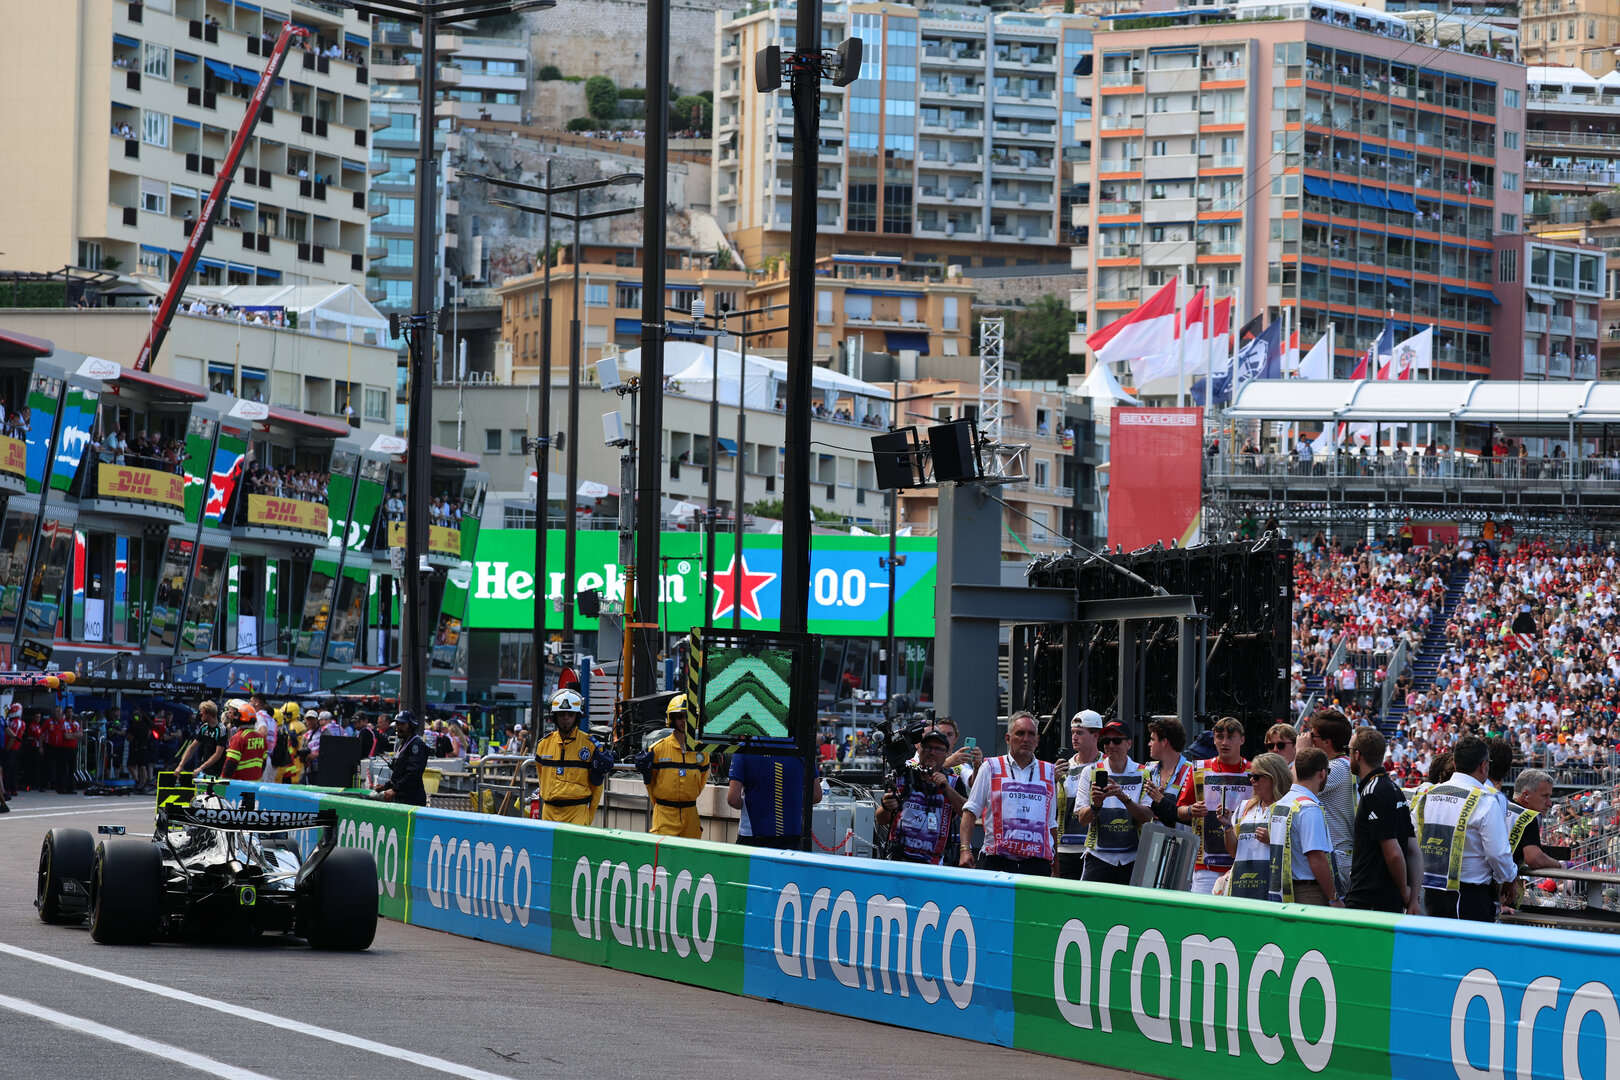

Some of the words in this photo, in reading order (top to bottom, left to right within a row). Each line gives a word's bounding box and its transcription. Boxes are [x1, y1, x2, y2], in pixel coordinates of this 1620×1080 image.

[1121, 414, 1195, 425] BELVEDERE
[115, 470, 154, 496] DHL
[264, 500, 299, 522] DHL
[17, 677, 32, 686] Bull
[195, 809, 318, 826] CROWDSTRIKE
[1021, 805, 1031, 813] TV
[1456, 794, 1478, 832] MONACO
[1004, 829, 1044, 844] MEDIA
[1509, 812, 1532, 846] MONACO
[1002, 840, 1019, 850] PIT
[1021, 842, 1041, 853] LANE
[427, 834, 532, 928] aramco
[571, 855, 718, 963] aramco
[774, 882, 976, 1010] aramco
[1053, 918, 1338, 1073] aramco
